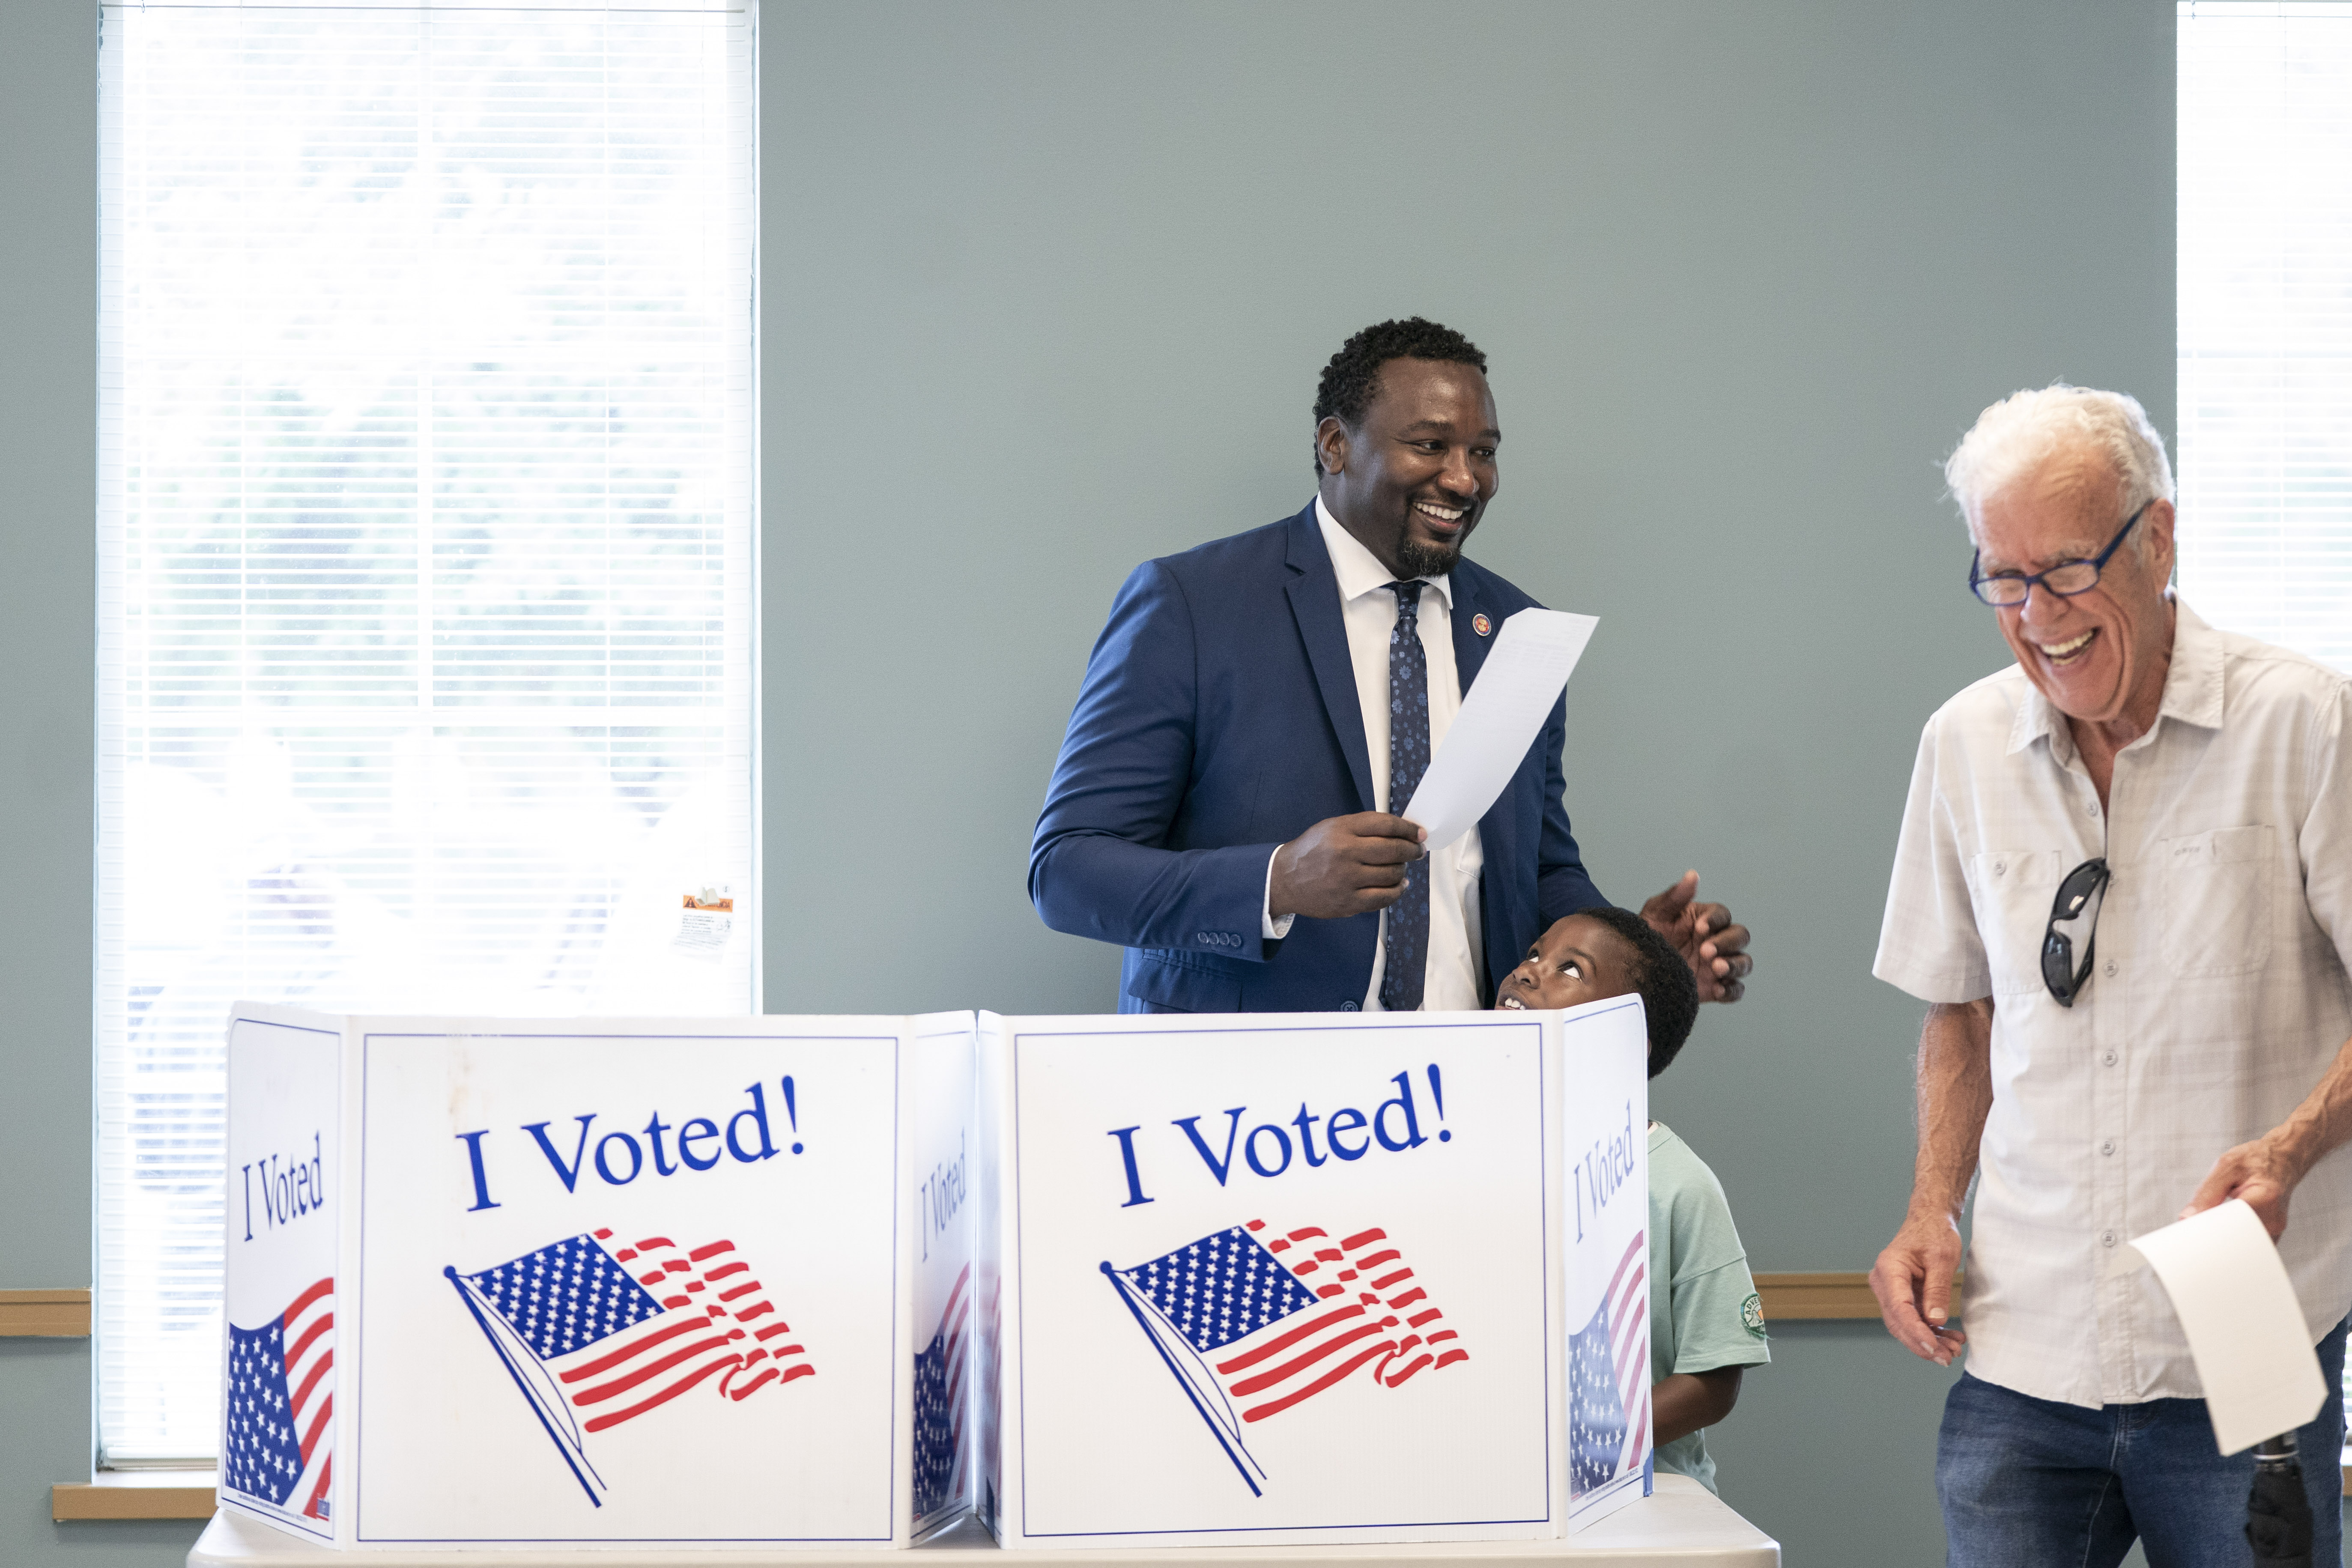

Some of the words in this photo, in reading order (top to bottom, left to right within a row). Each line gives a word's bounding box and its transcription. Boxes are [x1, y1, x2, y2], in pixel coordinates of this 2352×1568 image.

[242, 1164, 254, 1242] I
[258, 1129, 324, 1230] Voted
[455, 1129, 501, 1212] I
[520, 1075, 804, 1194] Voted!
[921, 1182, 928, 1263] I
[930, 1126, 966, 1241] Voted
[1107, 1125, 1155, 1208] I
[1171, 1063, 1452, 1187] Voted!
[1573, 1163, 1583, 1245] I
[1585, 1098, 1635, 1219] Voted
[1746, 1297, 1759, 1315] ADVE
